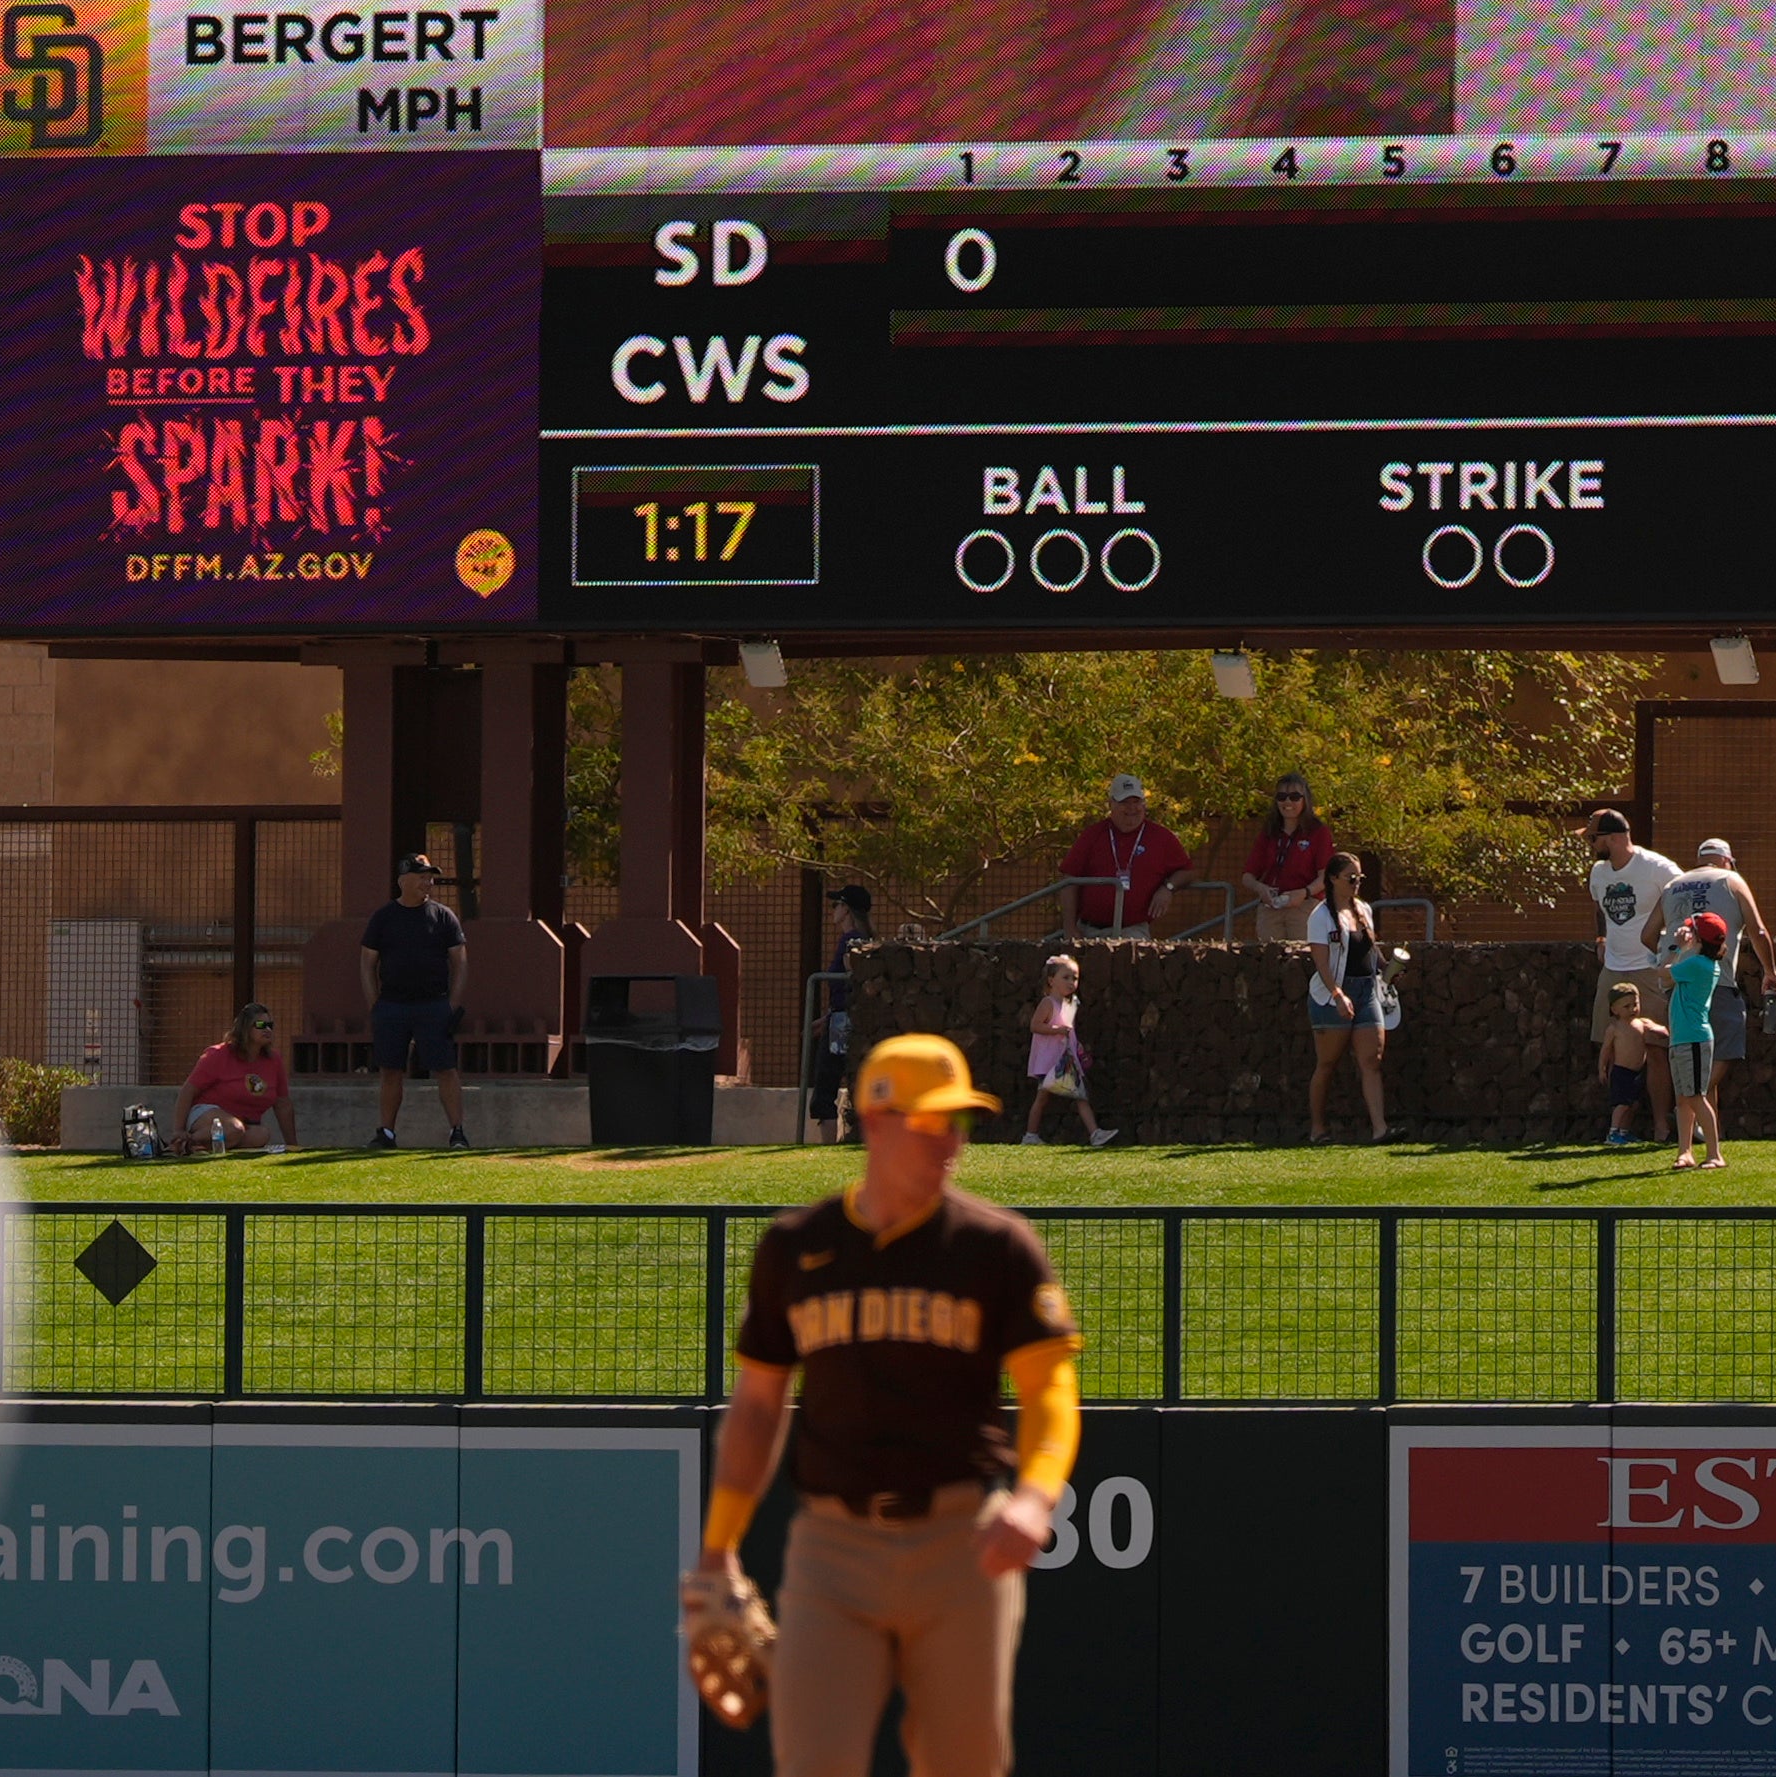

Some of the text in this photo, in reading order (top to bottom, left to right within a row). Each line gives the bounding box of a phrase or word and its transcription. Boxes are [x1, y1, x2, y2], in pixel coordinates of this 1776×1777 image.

[186, 9, 499, 67] BERGERT
[357, 86, 484, 135] MPH
[957, 151, 975, 185] 1
[1058, 150, 1083, 184] 2
[1166, 149, 1190, 182] 3
[1271, 146, 1300, 180] 4
[1382, 145, 1407, 179] 5
[1490, 142, 1517, 177] 6
[1597, 142, 1625, 176] 7
[1704, 139, 1730, 174] 8
[175, 201, 331, 250] STOP
[653, 219, 770, 287] SD
[943, 227, 998, 293] 0
[75, 245, 432, 360] WILDFIRES
[106, 365, 397, 404] BEFORE THEY
[610, 334, 811, 405] CWS
[107, 414, 389, 536] SPARK!
[982, 465, 1147, 517] BALL
[1378, 458, 1606, 512] STRIKE
[632, 501, 758, 563] 1:17
[125, 551, 375, 583] DFFM.AZ.GOV
[1460, 1566, 1484, 1604] 7
[1500, 1566, 1720, 1606] BUILDERS
[1460, 1624, 1584, 1664] GOLF
[1658, 1627, 1737, 1666] 65+
